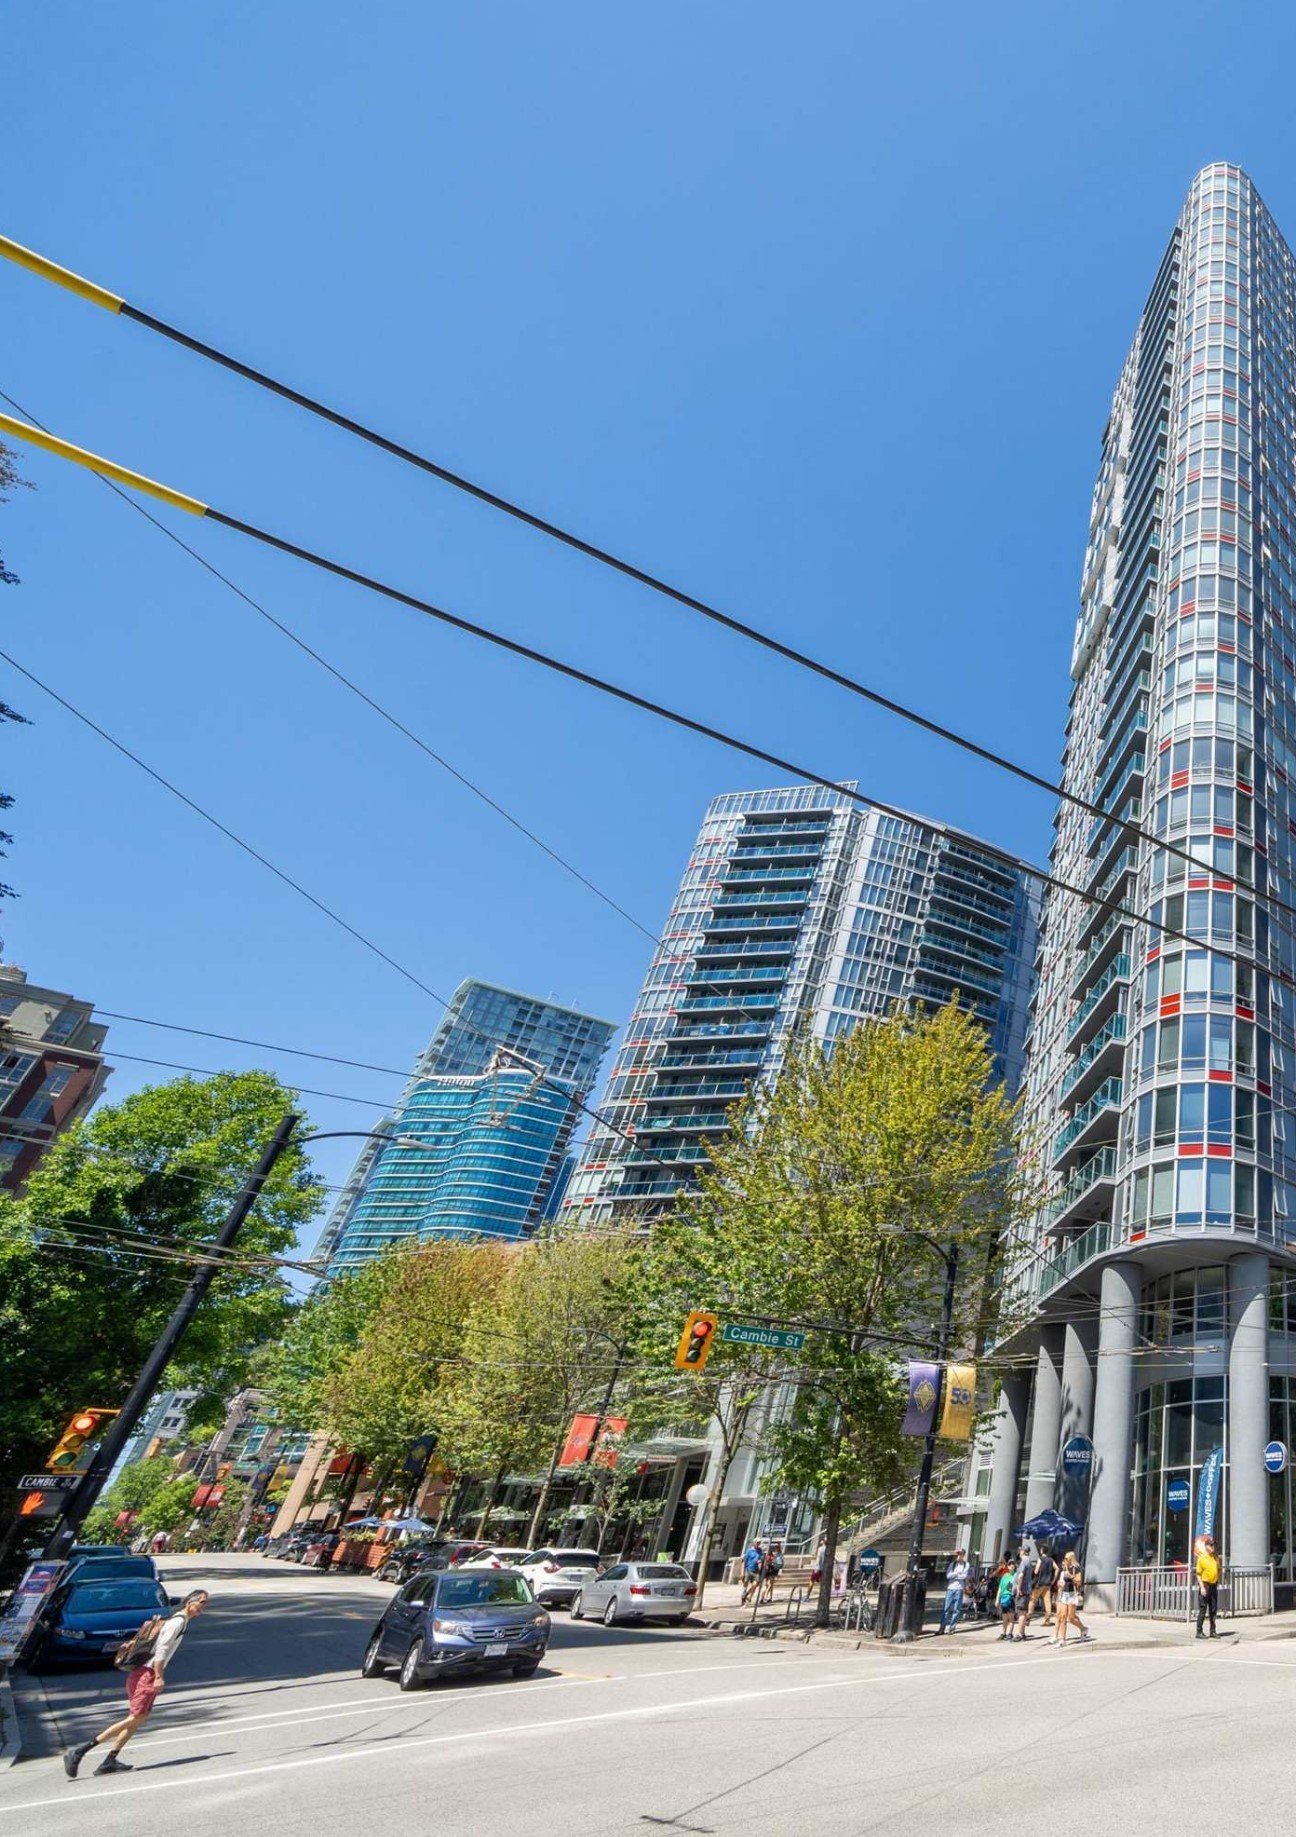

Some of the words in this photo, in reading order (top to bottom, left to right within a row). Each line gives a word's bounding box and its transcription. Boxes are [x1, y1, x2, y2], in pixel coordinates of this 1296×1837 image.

[730, 1327, 779, 1344] Cambie
[785, 1335, 799, 1346] St
[951, 1387, 972, 1405] 50
[1065, 1450, 1090, 1459] WAVES
[1206, 1453, 1218, 1492] COFFEE
[24, 1477, 59, 1487] CAMBIE
[1203, 1499, 1213, 1535] WAVES
